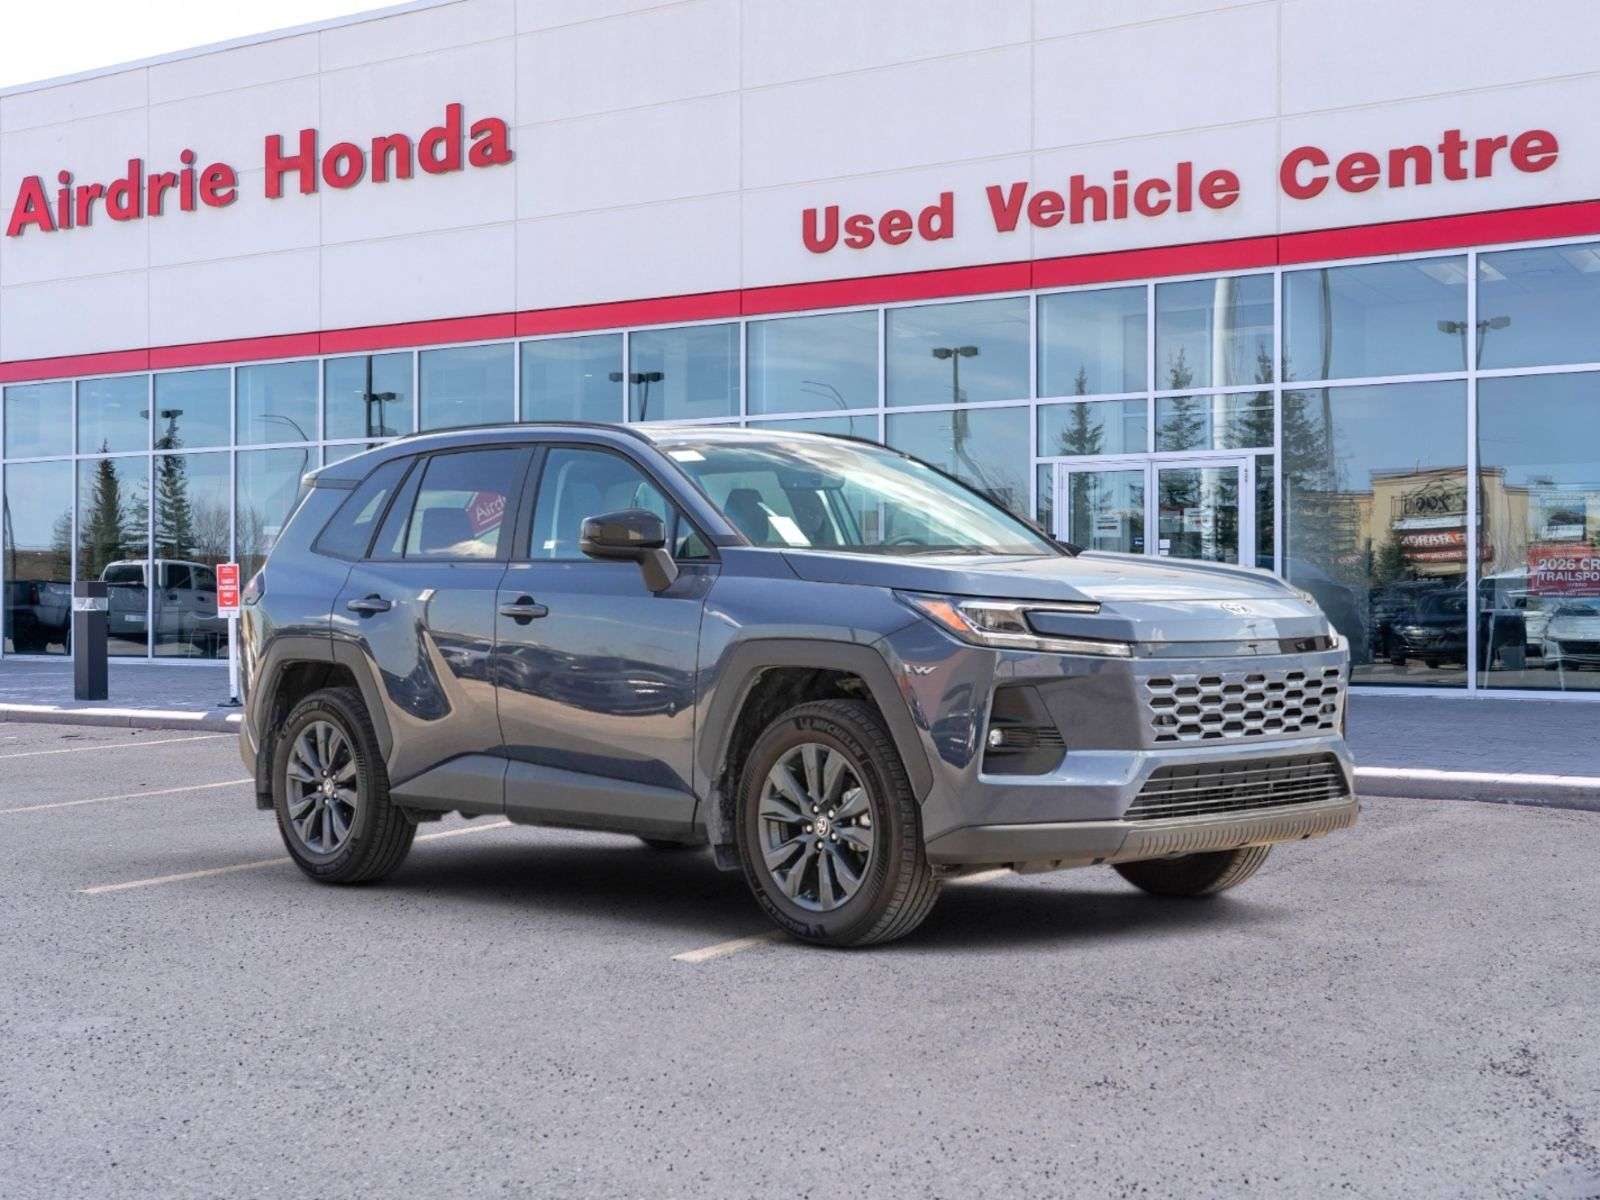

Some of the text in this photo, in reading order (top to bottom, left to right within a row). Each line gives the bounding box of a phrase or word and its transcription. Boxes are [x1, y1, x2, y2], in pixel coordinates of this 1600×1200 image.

[7, 103, 513, 237] Airdrie Honda
[802, 129, 1559, 254] Used Vehicle Centre
[1539, 558, 1576, 570] 2026
[1539, 570, 1600, 582] TRAILSPO
